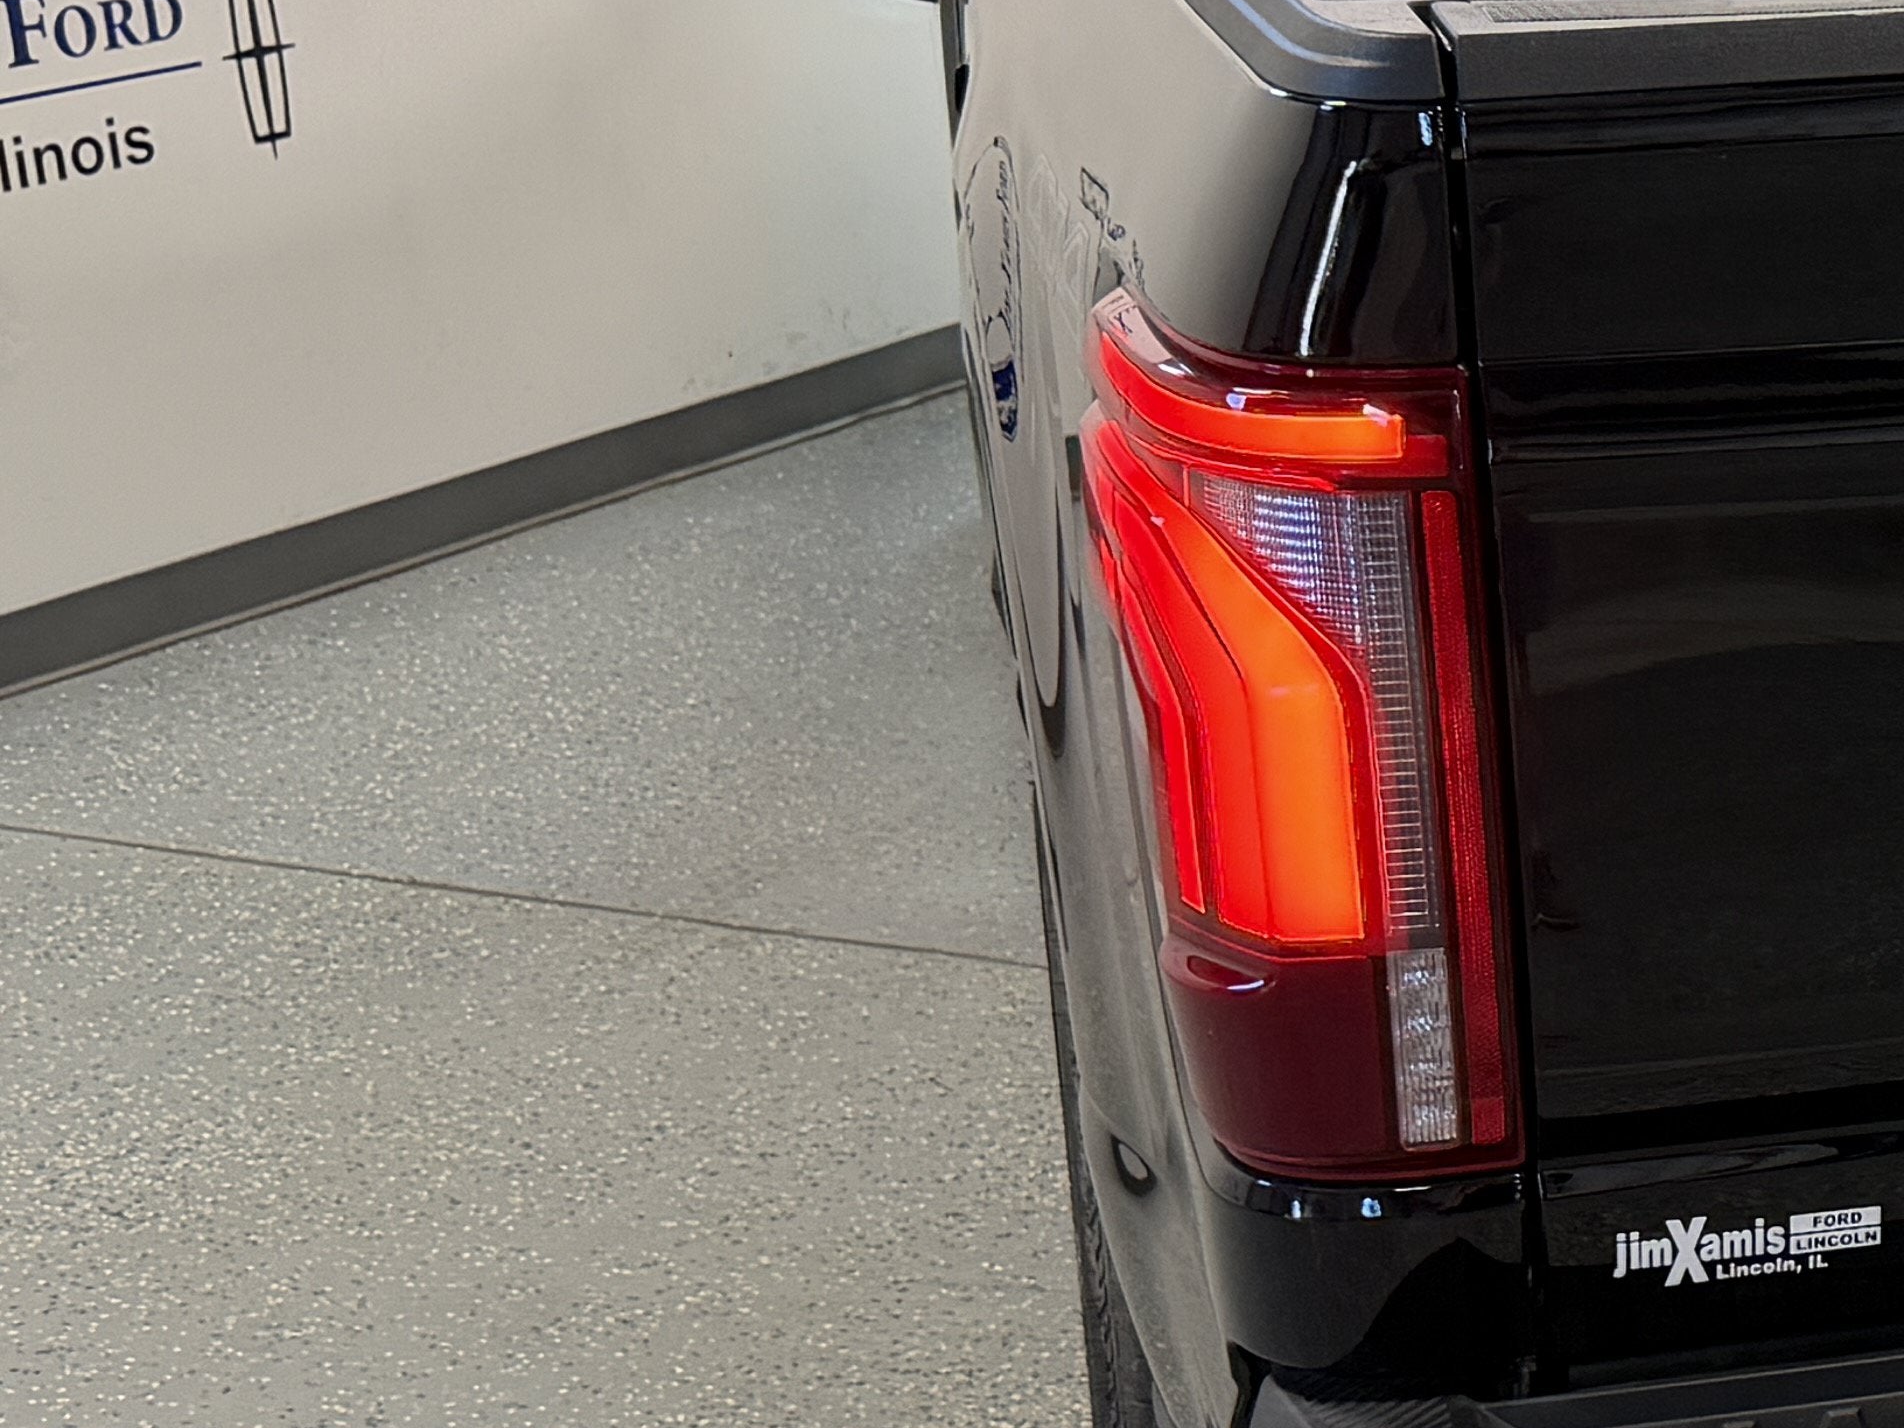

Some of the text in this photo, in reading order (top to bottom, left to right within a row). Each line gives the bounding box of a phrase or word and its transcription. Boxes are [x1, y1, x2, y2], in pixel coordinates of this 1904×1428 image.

[1812, 1211, 1863, 1228] FORD
[1613, 1216, 1787, 1287] jimXamis
[1796, 1230, 1878, 1252] LINCOLN
[1715, 1254, 1829, 1280] Lincoln, IL
